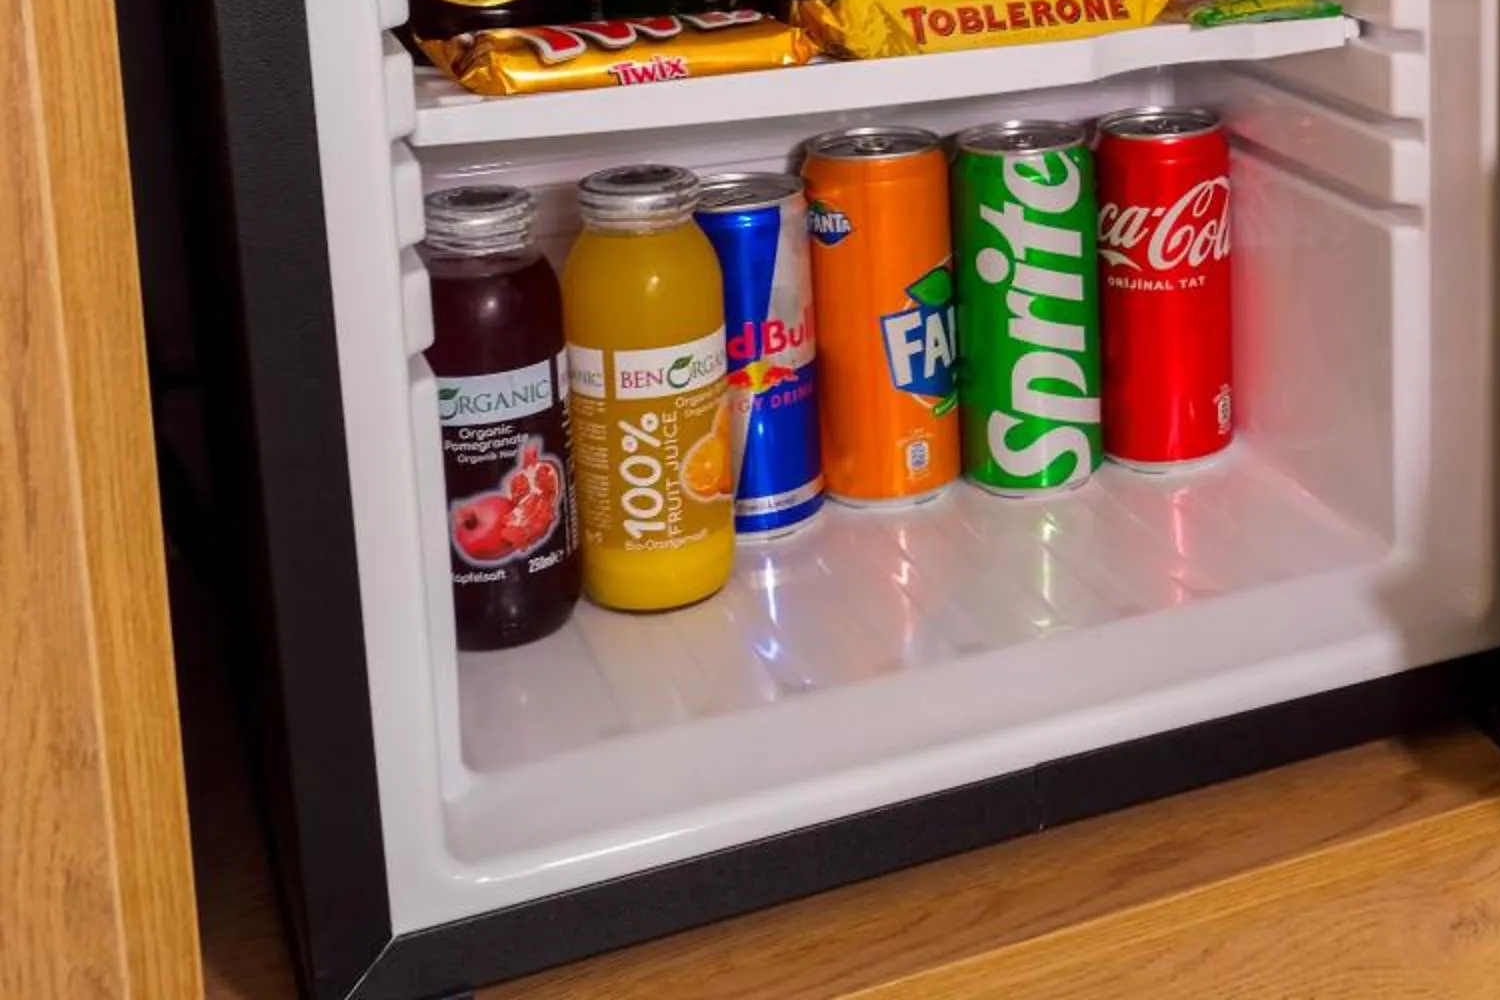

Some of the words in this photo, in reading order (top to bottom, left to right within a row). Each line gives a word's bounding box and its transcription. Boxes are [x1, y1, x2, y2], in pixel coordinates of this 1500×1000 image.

[1178, 275, 1206, 289] TAT
[976, 150, 1101, 489] Sprite
[459, 424, 513, 441] Organic
[661, 409, 681, 473] JUICE
[618, 411, 667, 541] 100%
[667, 478, 686, 536] FRUIT
